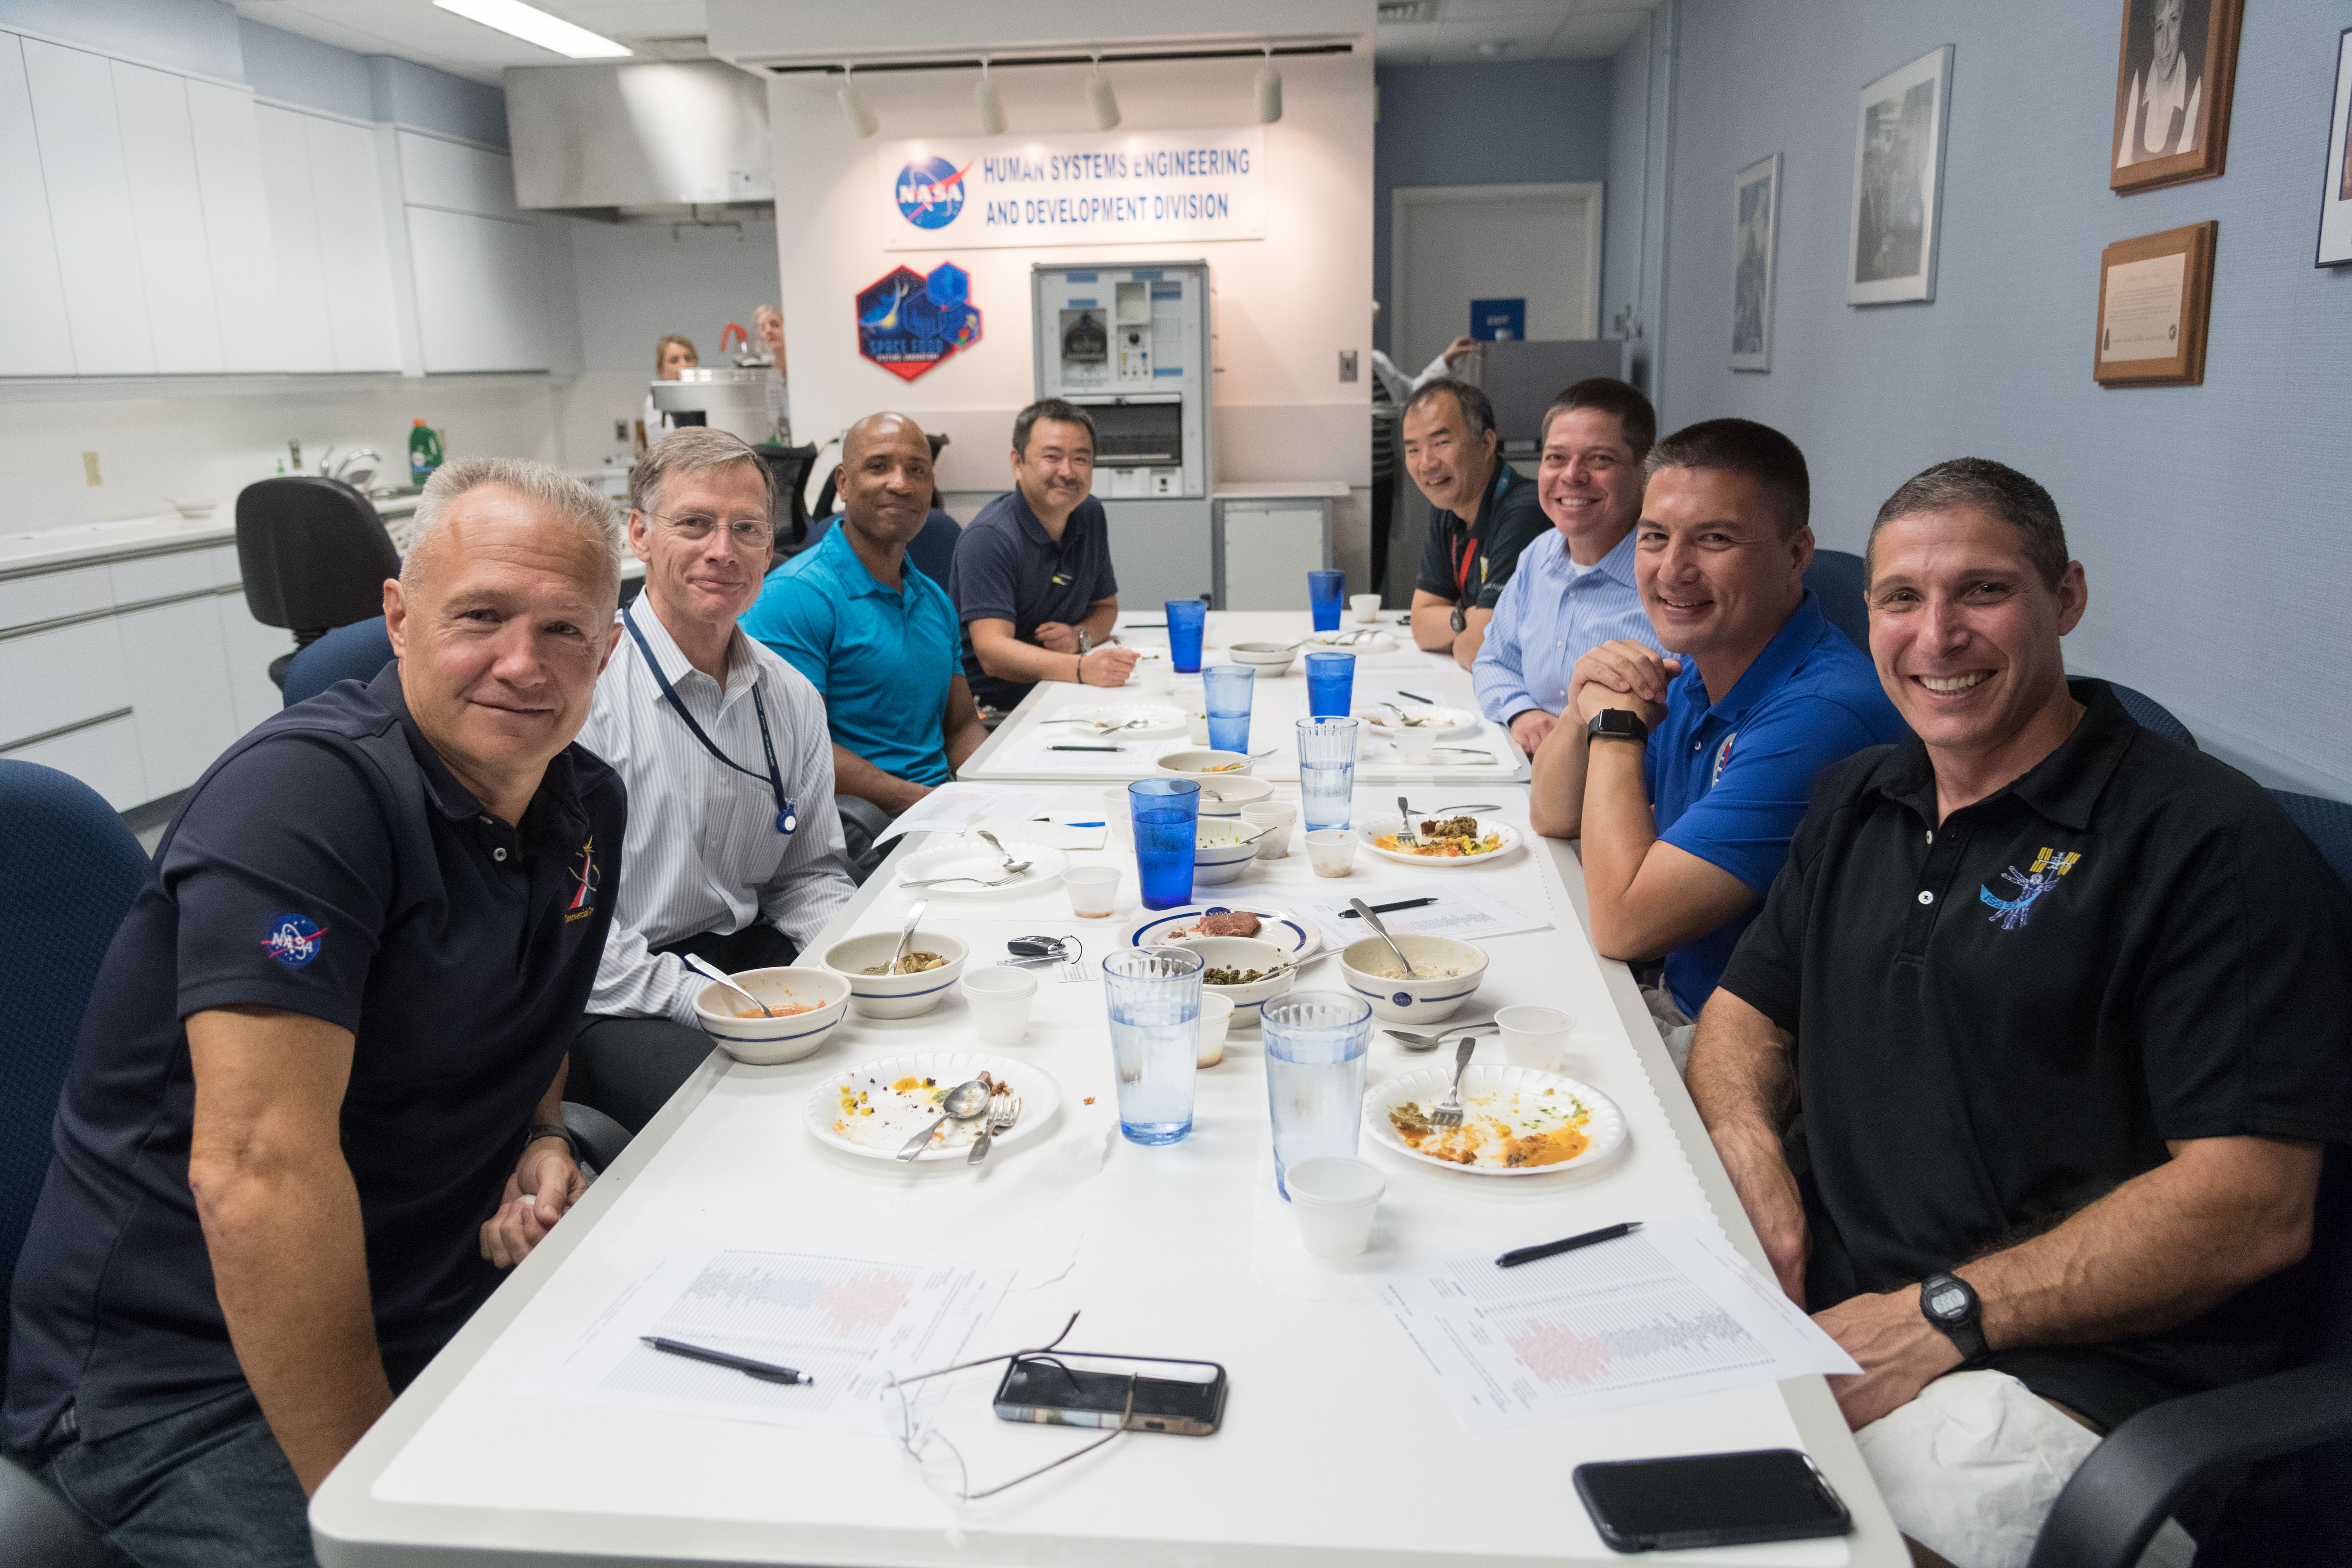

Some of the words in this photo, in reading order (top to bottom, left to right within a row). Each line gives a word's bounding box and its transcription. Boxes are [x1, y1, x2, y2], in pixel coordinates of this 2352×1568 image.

[984, 157, 1044, 182] HUMAN
[1051, 154, 1127, 180] SYSTEMS
[1135, 149, 1249, 177] ENGINEERING
[899, 183, 963, 203] NASA
[987, 200, 1019, 225] AND
[1026, 196, 1146, 223] DEVELOPMENT
[1155, 194, 1228, 219] DIVISION
[869, 338, 905, 355] SPACE
[1984, 895, 2003, 908] ISS
[565, 908, 588, 923] Commercial
[272, 932, 313, 953] NASA
